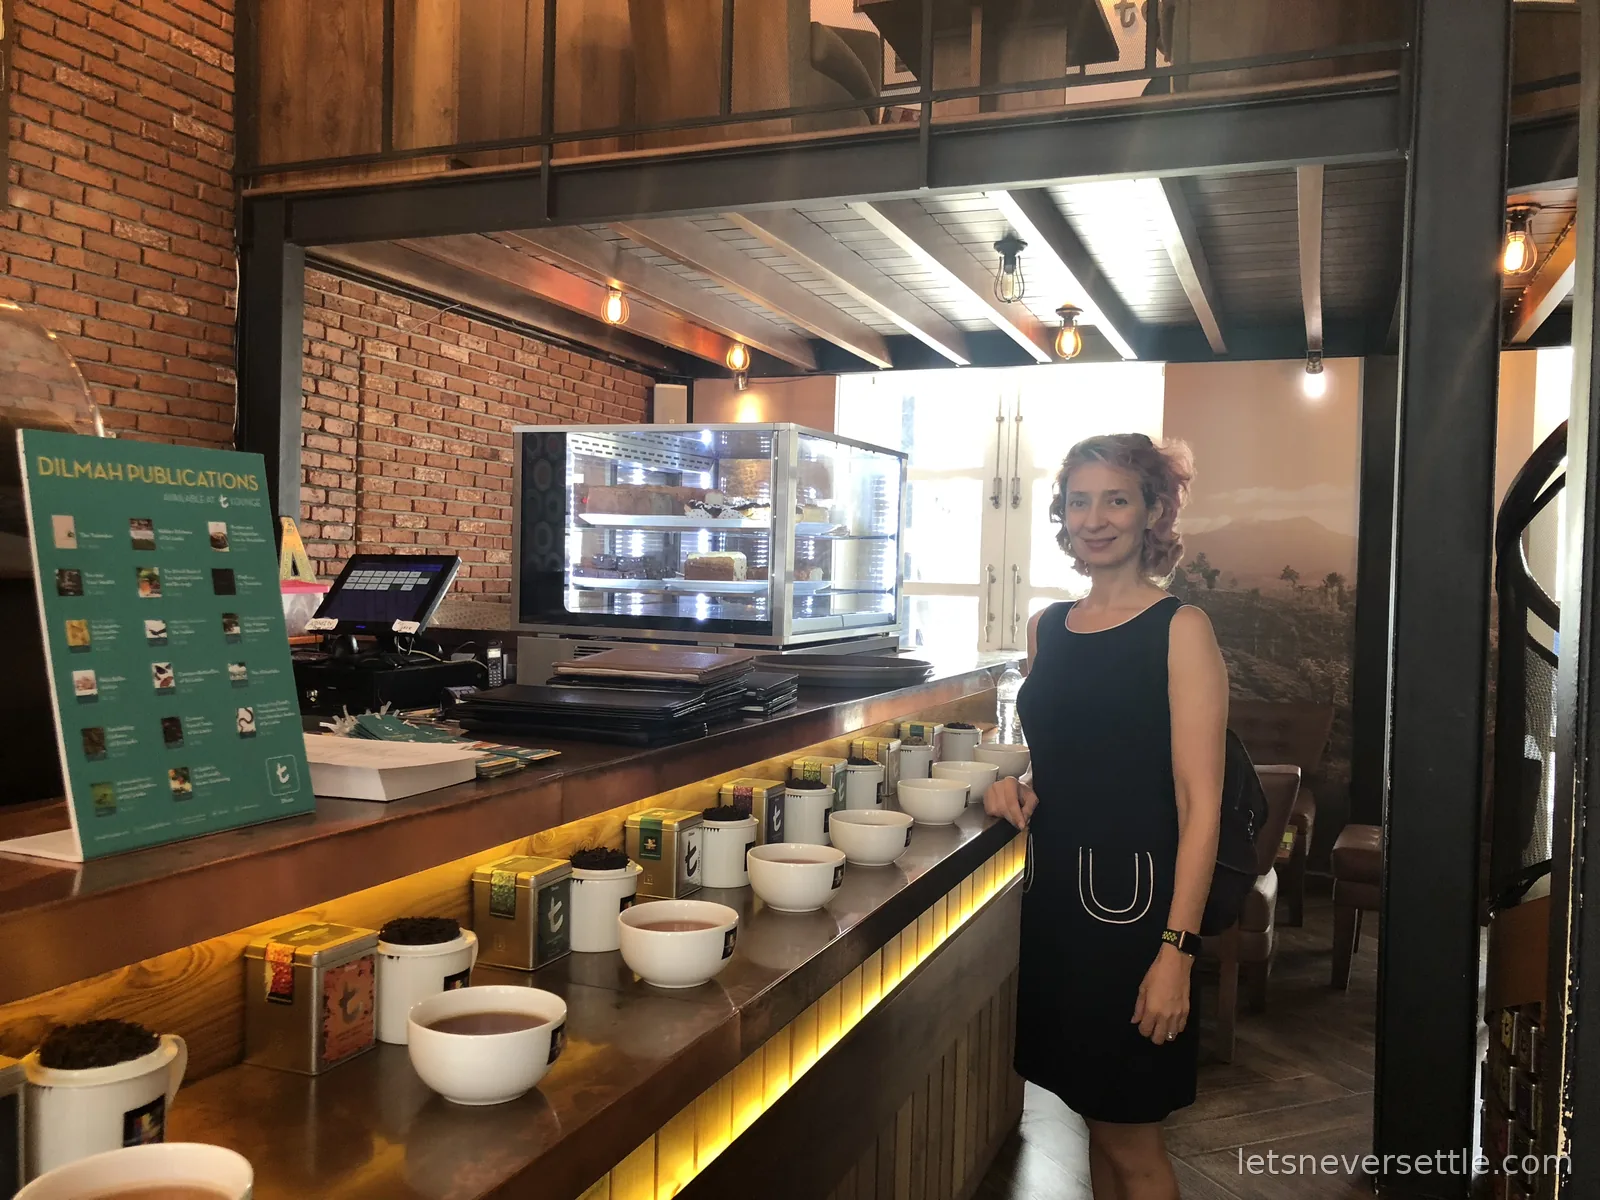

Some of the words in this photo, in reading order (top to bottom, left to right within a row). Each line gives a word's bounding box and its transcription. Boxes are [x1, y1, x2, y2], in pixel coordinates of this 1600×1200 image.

[37, 456, 123, 481] DILMAH
[127, 464, 259, 491] PUBLICATIONS
[276, 761, 290, 784] t
[772, 804, 782, 832] t
[685, 840, 697, 877] t
[548, 896, 564, 933] t
[339, 980, 364, 1025] t
